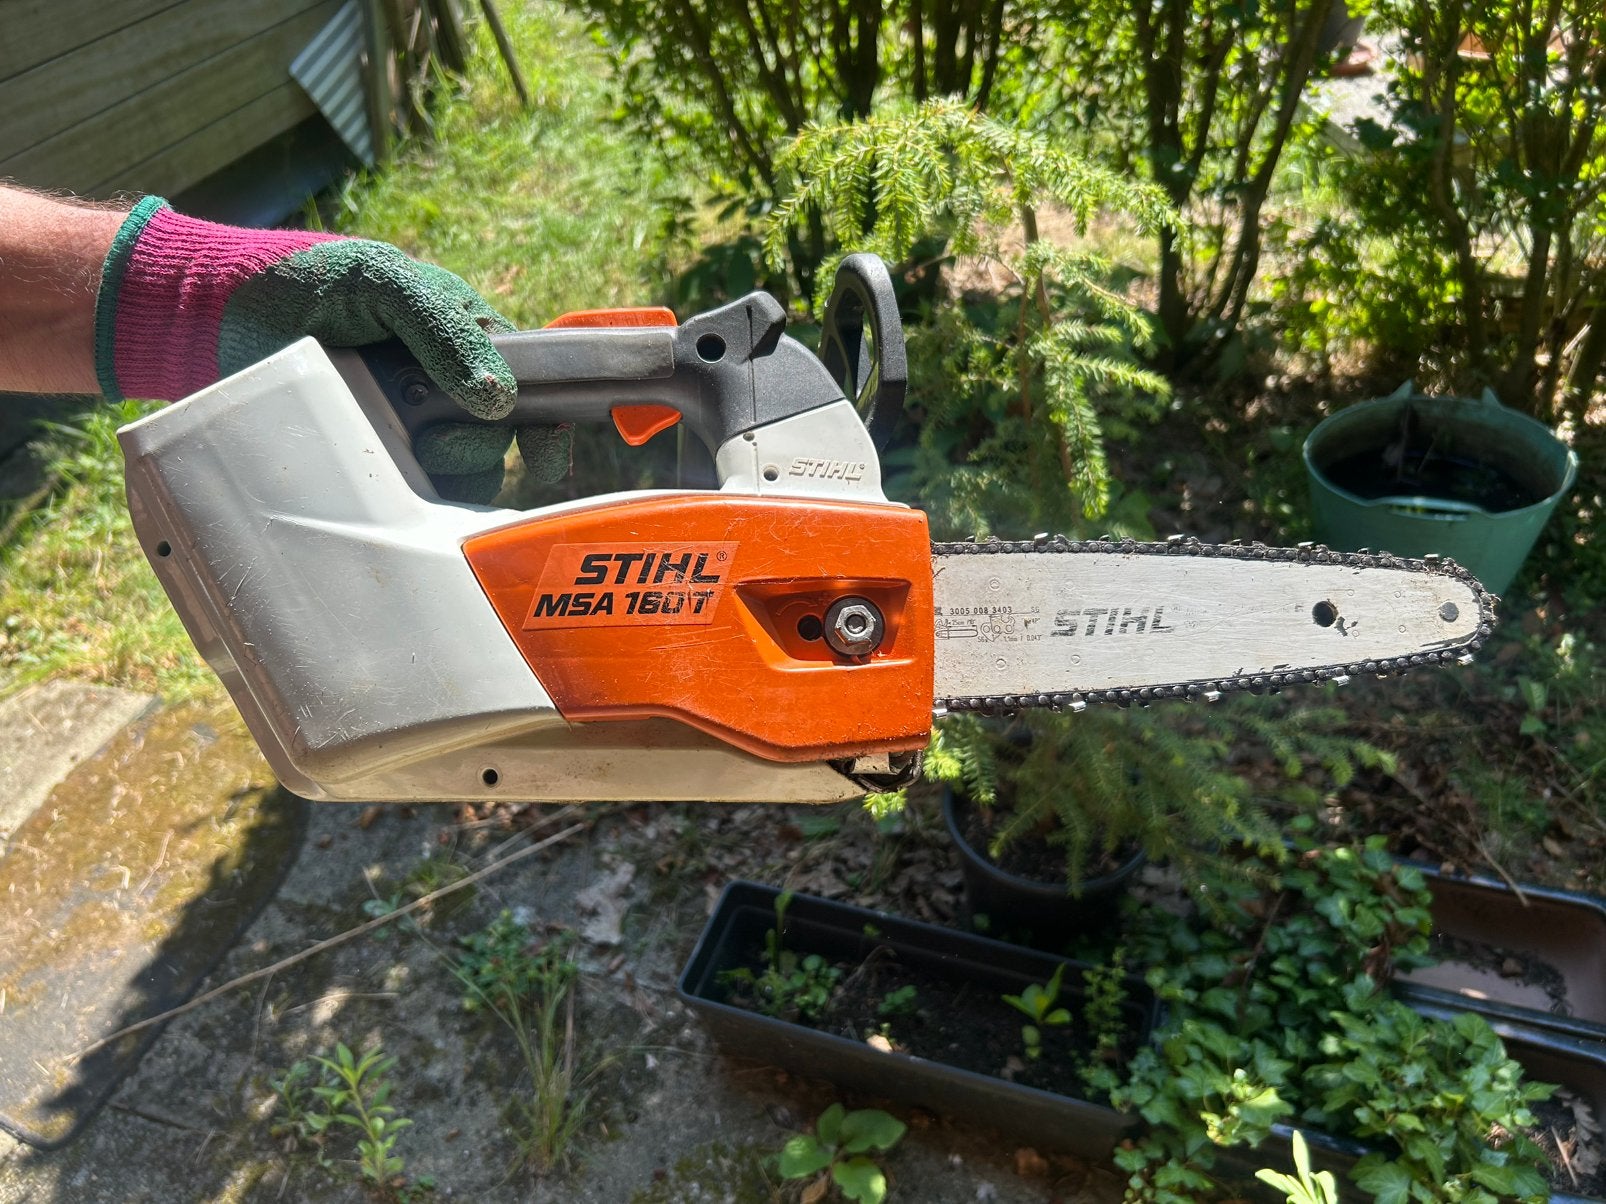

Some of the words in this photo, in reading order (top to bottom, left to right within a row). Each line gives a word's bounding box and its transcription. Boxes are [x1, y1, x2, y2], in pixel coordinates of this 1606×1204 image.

[533, 592, 614, 618] MSA
[949, 607, 970, 615] 3005
[973, 606, 989, 615] 008
[992, 606, 1012, 614] 3403
[1049, 605, 1174, 637] STIHL
